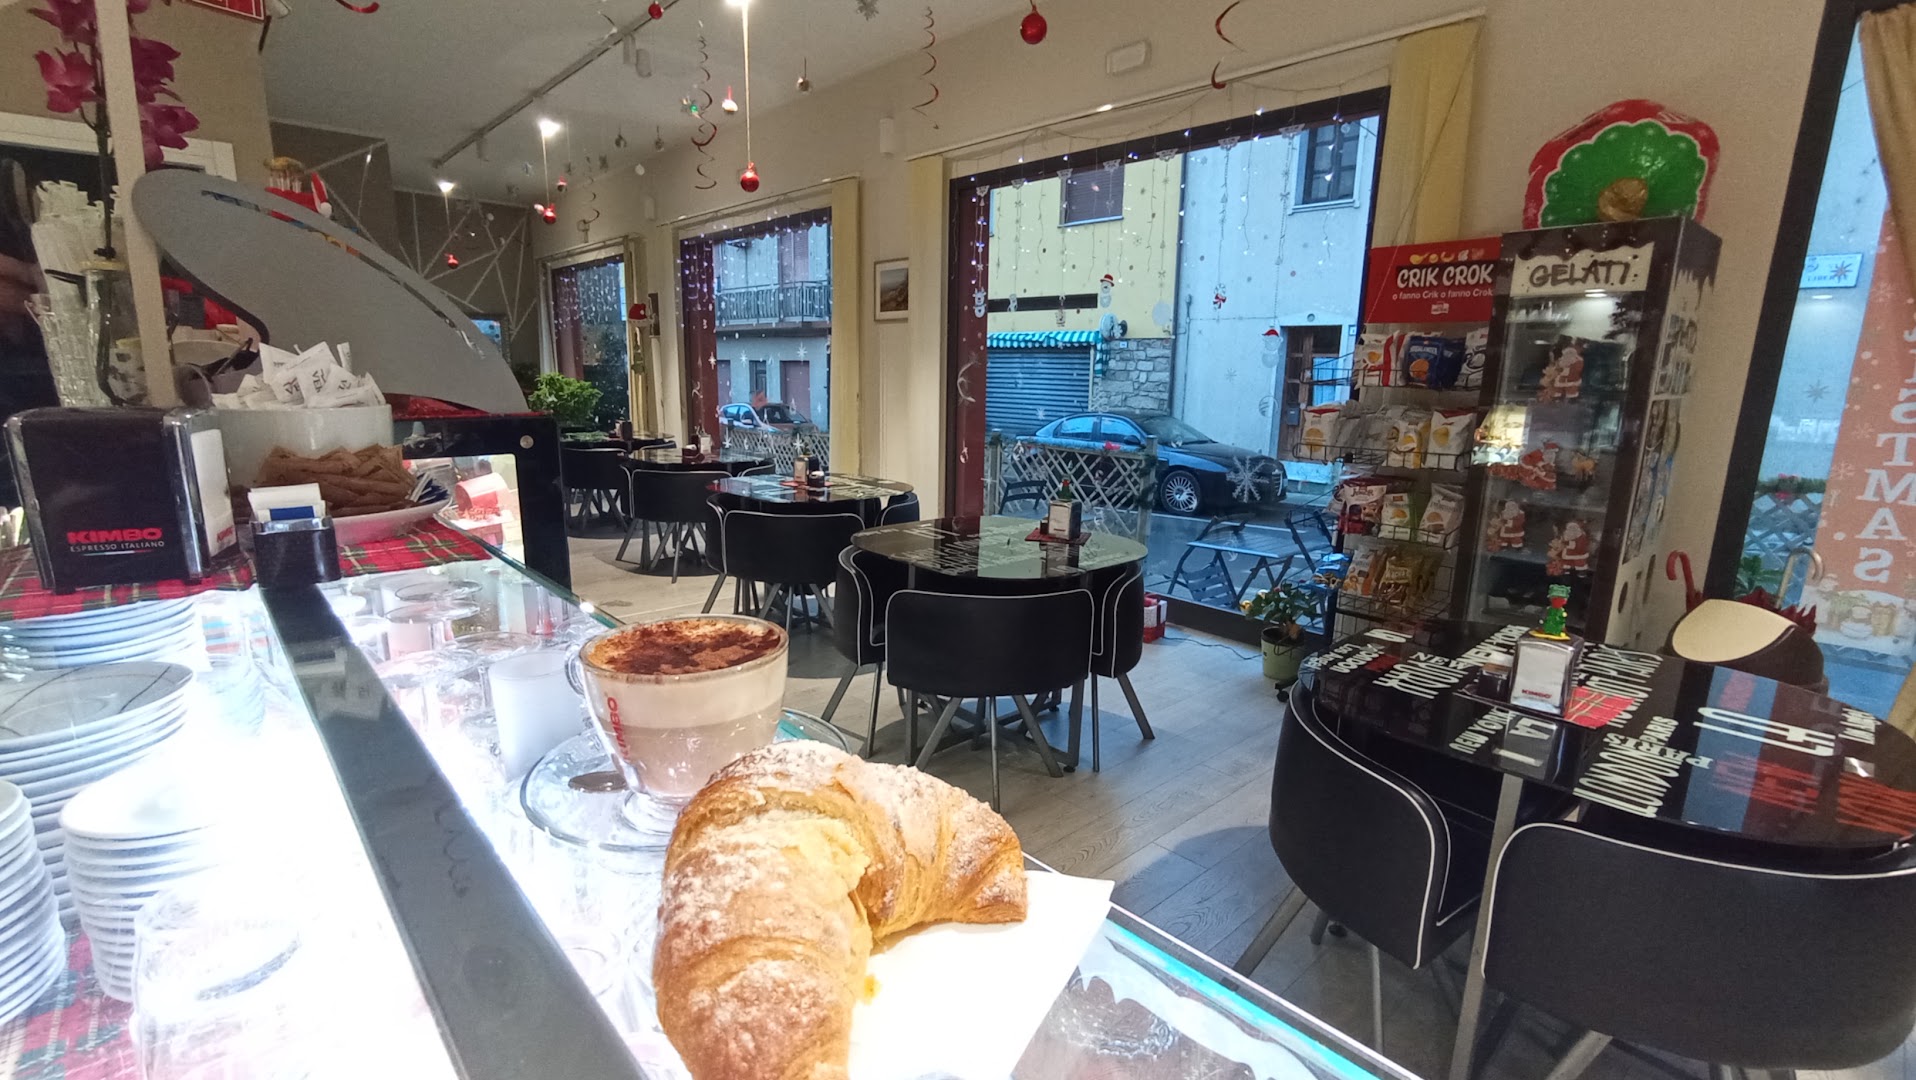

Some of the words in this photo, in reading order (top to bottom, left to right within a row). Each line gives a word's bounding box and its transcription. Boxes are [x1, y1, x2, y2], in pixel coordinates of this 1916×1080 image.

[1397, 267, 1440, 288] CRIK
[1442, 263, 1495, 286] CROK
[1529, 258, 1632, 288] GELATI
[67, 528, 163, 544] KIMBO
[70, 543, 118, 552] ESPRESSO
[120, 539, 165, 551] ITALIANO
[1410, 651, 1474, 670] NEW
[1639, 715, 1680, 746] PARIS
[1602, 732, 1714, 769] PARIS
[1573, 743, 1682, 819] LONDON
